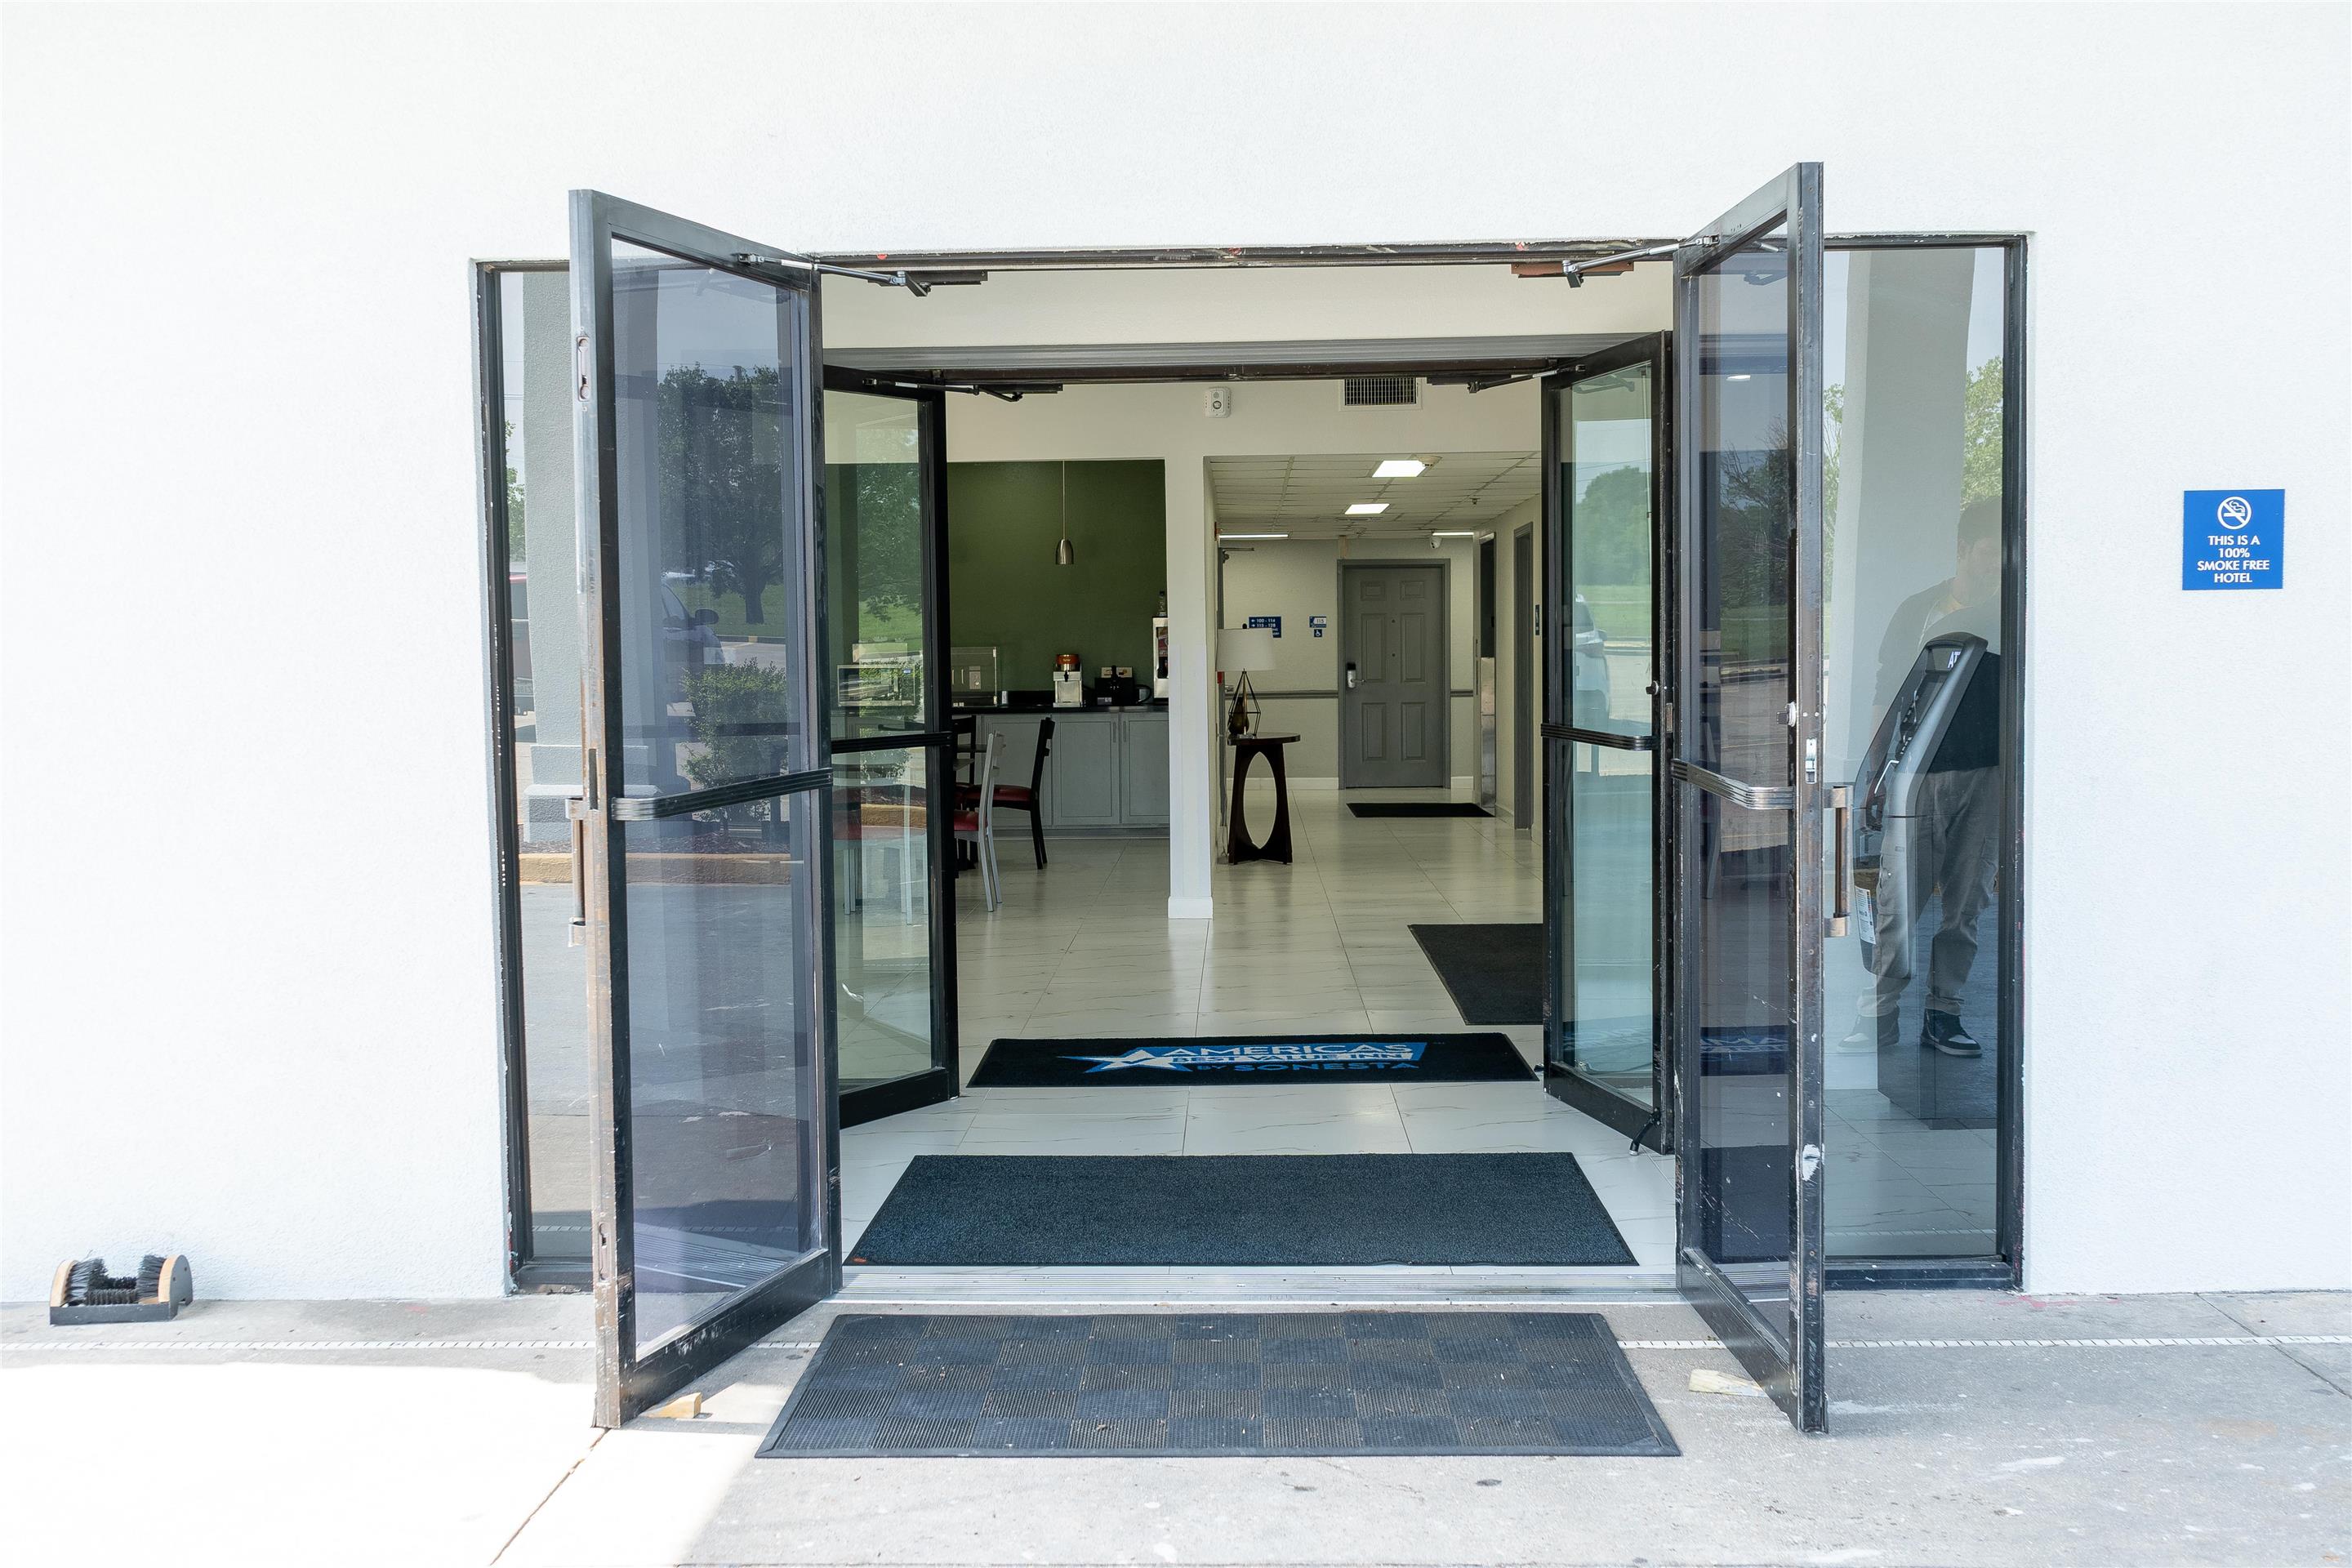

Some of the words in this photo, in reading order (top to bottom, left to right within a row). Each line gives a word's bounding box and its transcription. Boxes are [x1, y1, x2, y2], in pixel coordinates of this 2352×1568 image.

[2207, 535, 2234, 546] THIS
[2238, 535, 2247, 546] IS
[2250, 535, 2261, 546] A
[2218, 547, 2251, 558] 100%
[2197, 560, 2240, 571] SMOKE
[2243, 559, 2270, 570] FREE
[2214, 572, 2253, 583] HOTEL
[1160, 1044, 1412, 1056] AMERICAS
[1234, 1062, 1419, 1071] SONESTA
